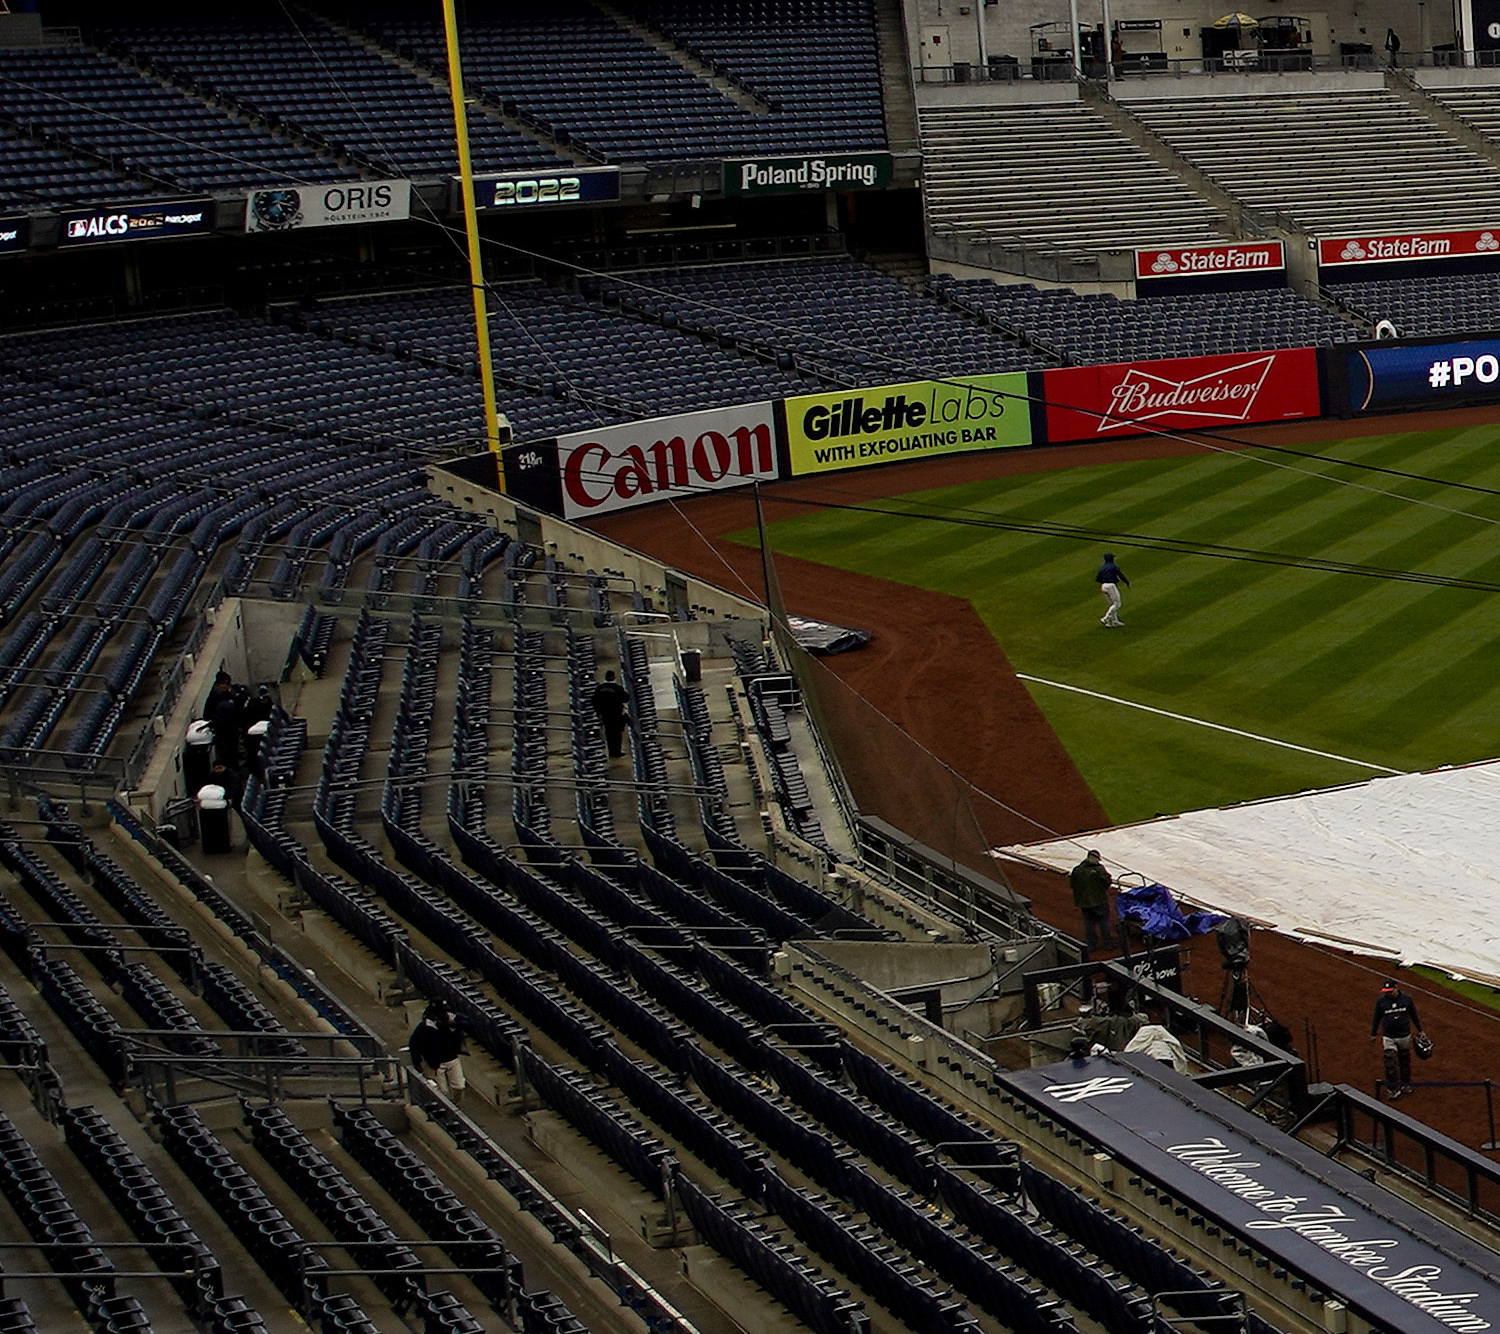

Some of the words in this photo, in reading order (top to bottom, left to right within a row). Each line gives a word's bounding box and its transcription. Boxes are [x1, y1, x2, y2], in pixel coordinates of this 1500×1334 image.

[494, 177, 580, 205] 2022
[741, 160, 809, 189] Poland
[810, 160, 875, 187] Spring
[324, 185, 391, 211] ORIS
[86, 214, 129, 237] ALCS
[803, 393, 926, 441] Gillette
[929, 381, 1005, 424] Labs
[1112, 378, 1259, 413] Budweiser
[815, 444, 856, 463] WITH
[859, 433, 957, 460] EXFOLIATING
[961, 426, 997, 446] BAR
[564, 422, 773, 509] Canon
[1166, 1136, 1275, 1205] Welcome
[1273, 1193, 1307, 1213] to
[1246, 1203, 1399, 1269] Yankee
[1368, 1264, 1494, 1334] Stadium
